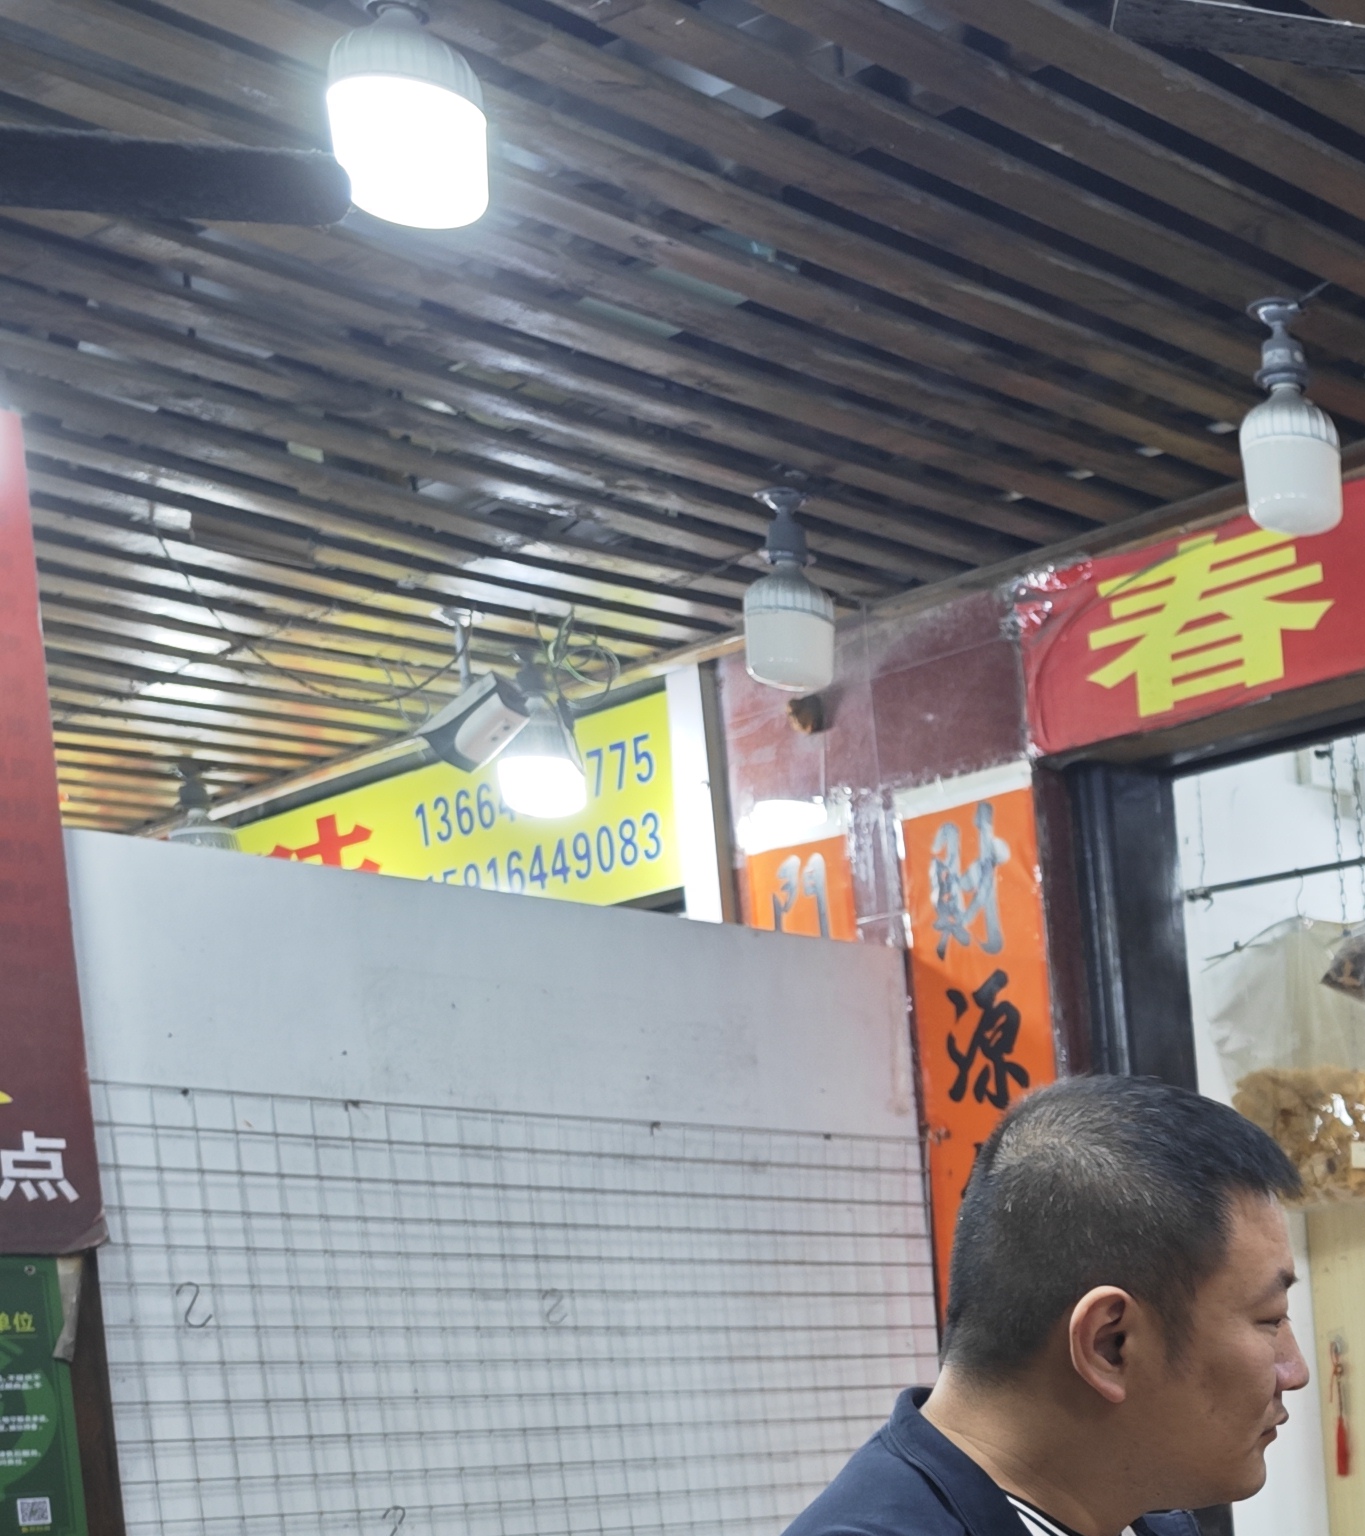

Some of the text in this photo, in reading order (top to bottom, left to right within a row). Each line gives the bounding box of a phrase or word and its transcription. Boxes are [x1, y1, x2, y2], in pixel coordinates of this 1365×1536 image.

[414, 733, 655, 848] 1366775
[425, 812, 662, 892] 16449083
[929, 800, 1030, 1200] 財源
[0, 1130, 79, 1202] 点
